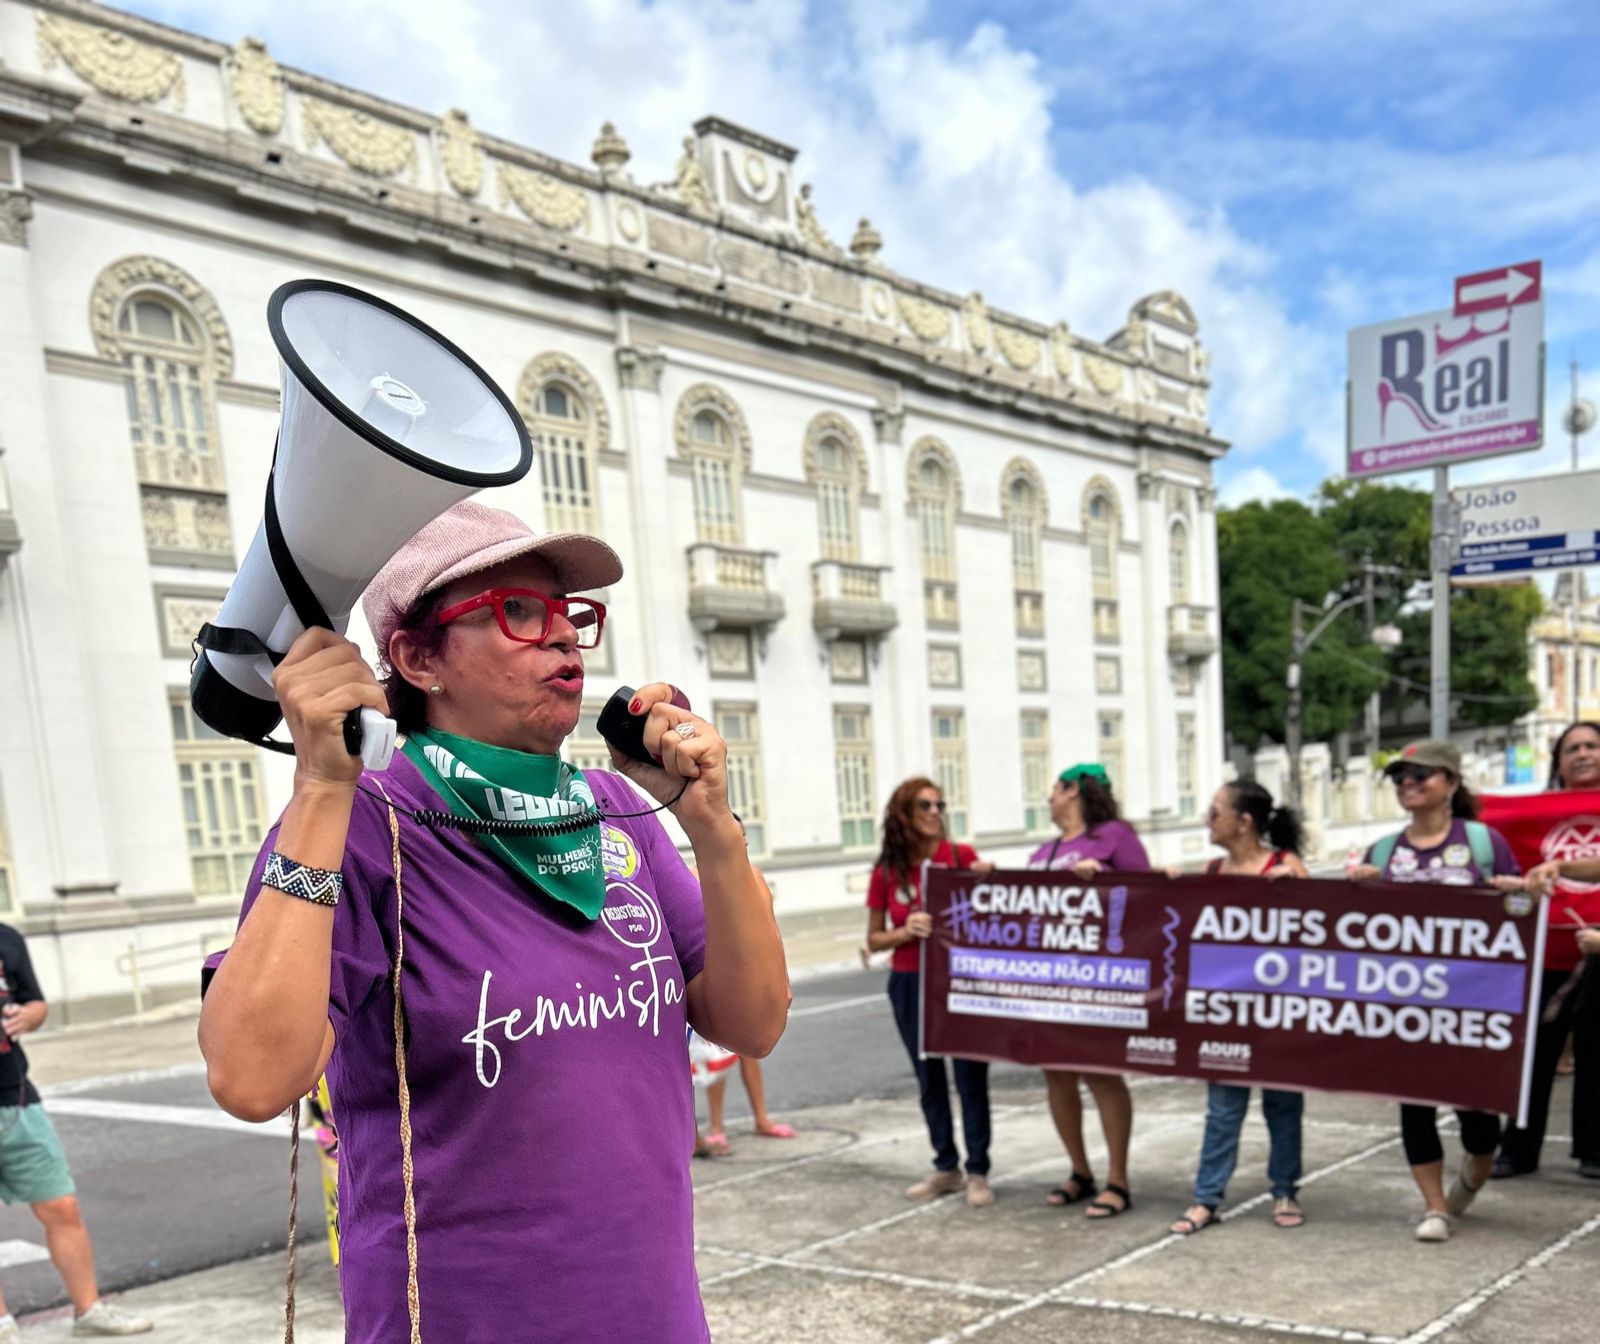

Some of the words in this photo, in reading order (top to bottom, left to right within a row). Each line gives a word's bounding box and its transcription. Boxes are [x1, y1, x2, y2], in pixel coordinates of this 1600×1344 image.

[1378, 328, 1509, 430] Real
[1462, 485, 1516, 510] João
[1462, 515, 1541, 538] Pessoa
[536, 847, 592, 865] MULHERES
[537, 864, 558, 875] DO
[562, 859, 590, 875] PSOL
[603, 903, 648, 921] RESISTÊNCIA
[628, 923, 645, 933] PSOL
[967, 914, 1023, 944] NÃO
[1026, 914, 1041, 947] É
[1042, 914, 1100, 951] MÃE
[1190, 905, 1328, 946] ADUFS
[1335, 911, 1527, 960] CONTRA
[951, 955, 1051, 980] ESTUPRADOR
[1053, 959, 1096, 982] NÃO
[1097, 961, 1109, 984] É
[1253, 950, 1290, 987] O
[1299, 953, 1346, 992] PL
[1355, 957, 1450, 1000] DOS
[461, 956, 684, 1088] feminista
[1184, 989, 1514, 1050] ESTUPRADORES
[1126, 1036, 1177, 1053] ANDES
[1198, 1041, 1251, 1060] ADUFS
